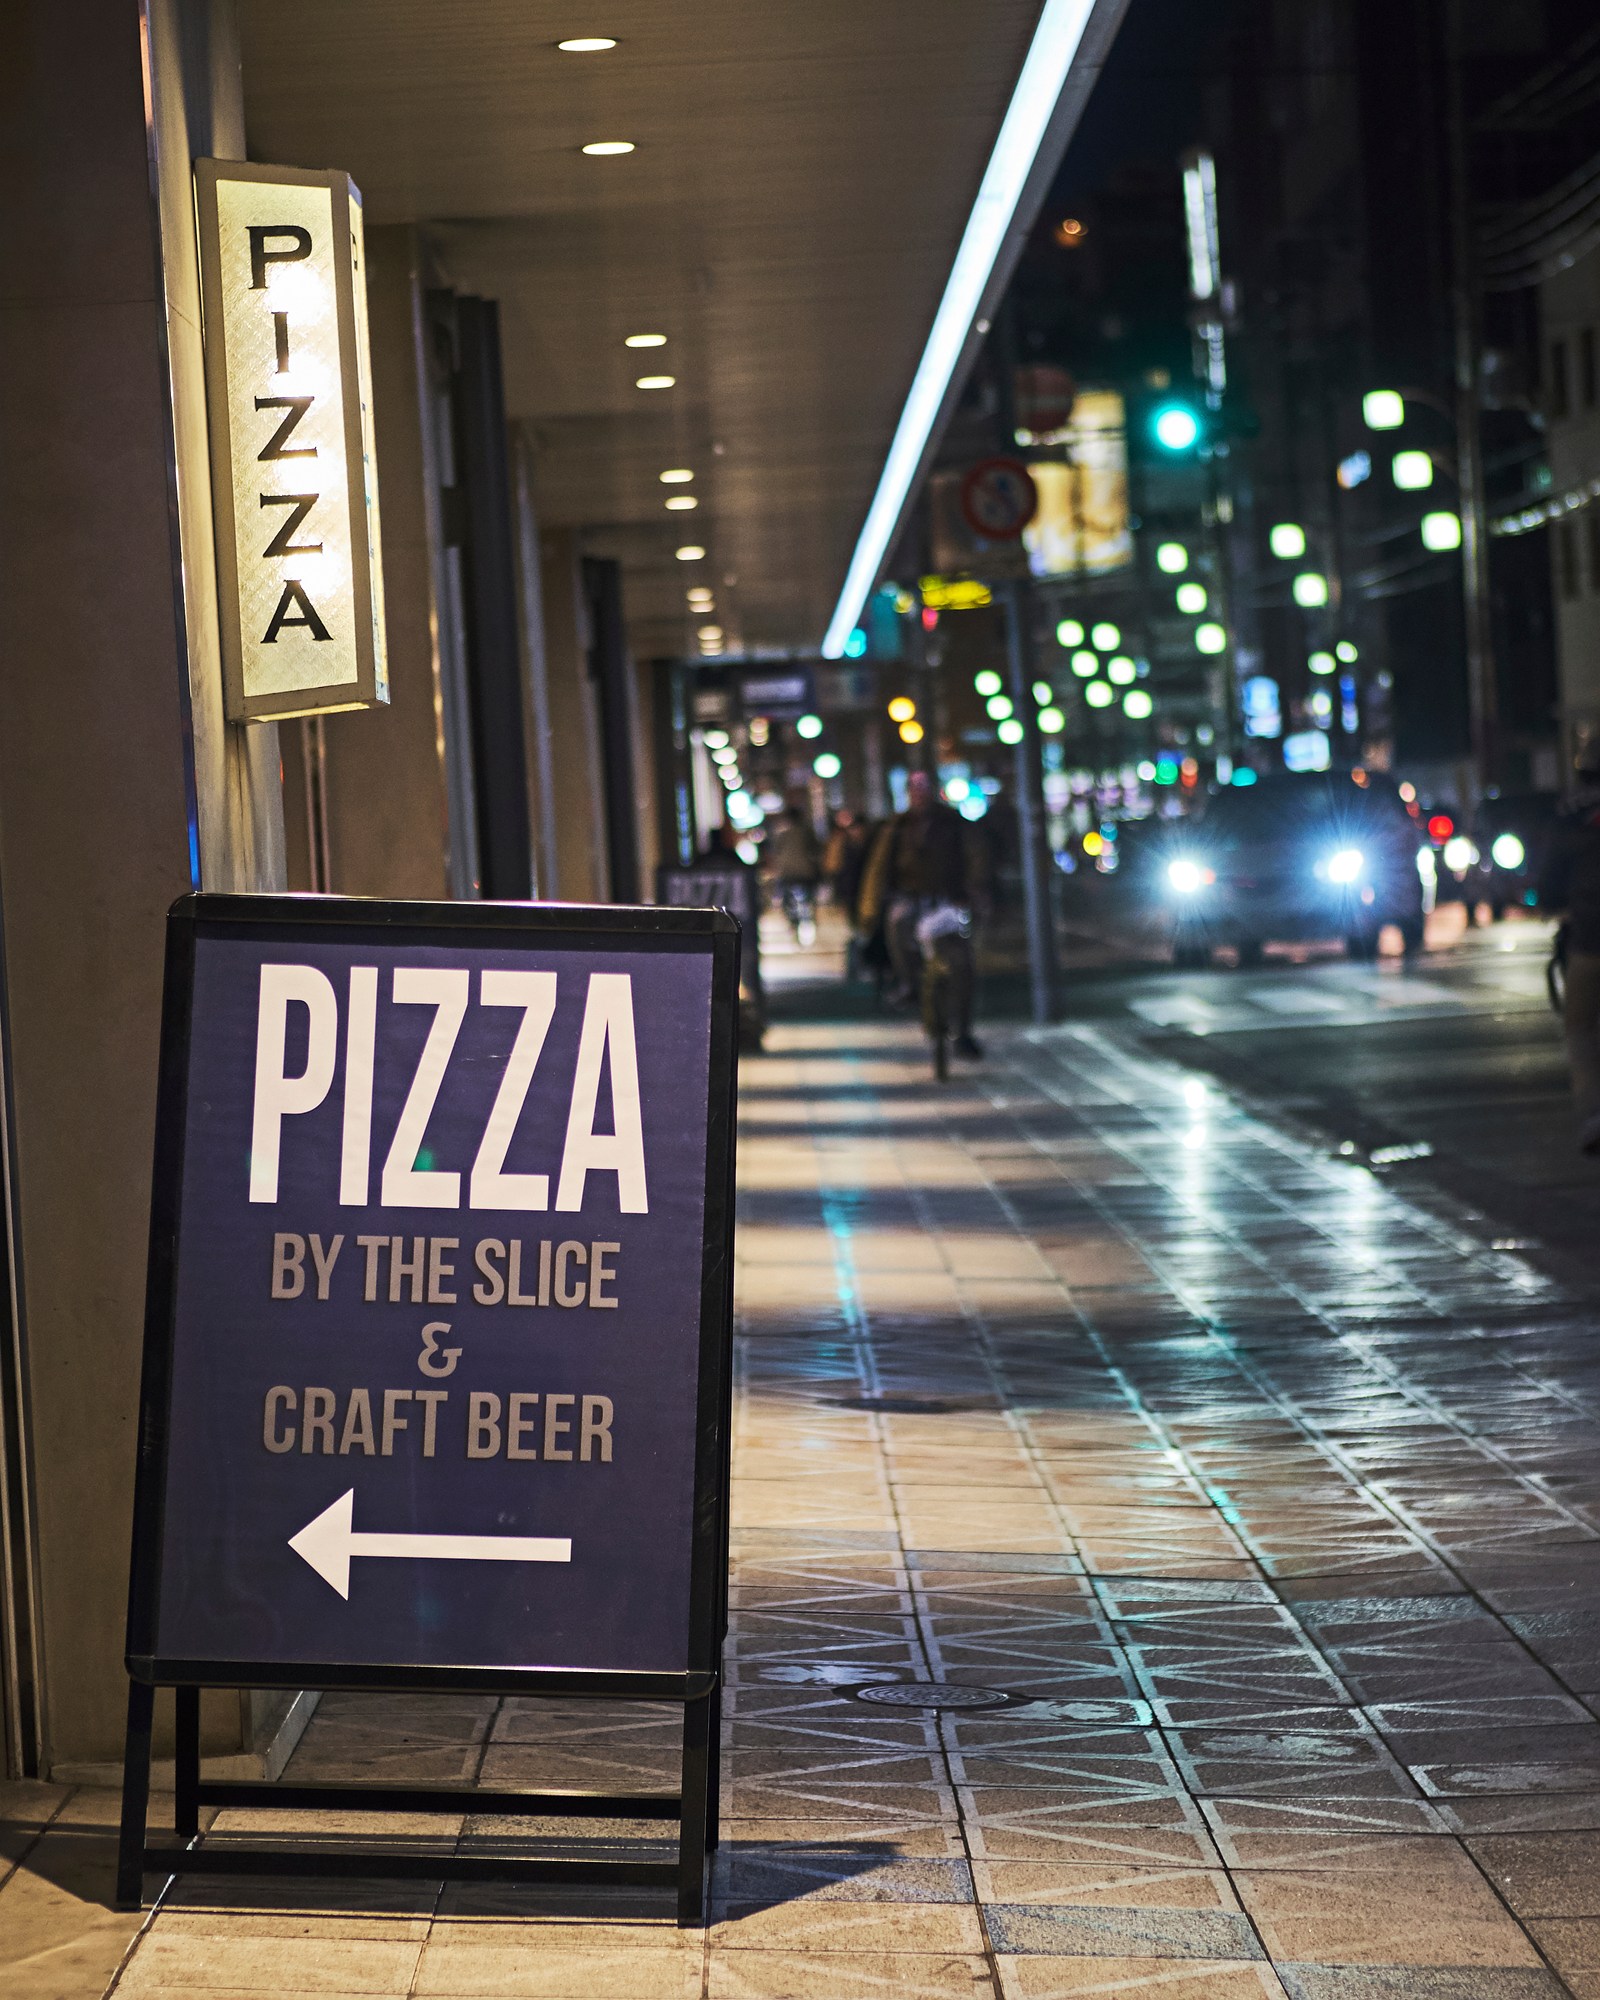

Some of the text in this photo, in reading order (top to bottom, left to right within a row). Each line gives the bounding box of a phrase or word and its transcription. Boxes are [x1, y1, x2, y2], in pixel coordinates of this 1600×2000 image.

[245, 226, 333, 644] PIZZA
[249, 964, 648, 1213] PIZZA
[272, 1233, 620, 1308] BY THE SLICE
[418, 1322, 462, 1377] &
[264, 1386, 613, 1462] CRAFT BEER
